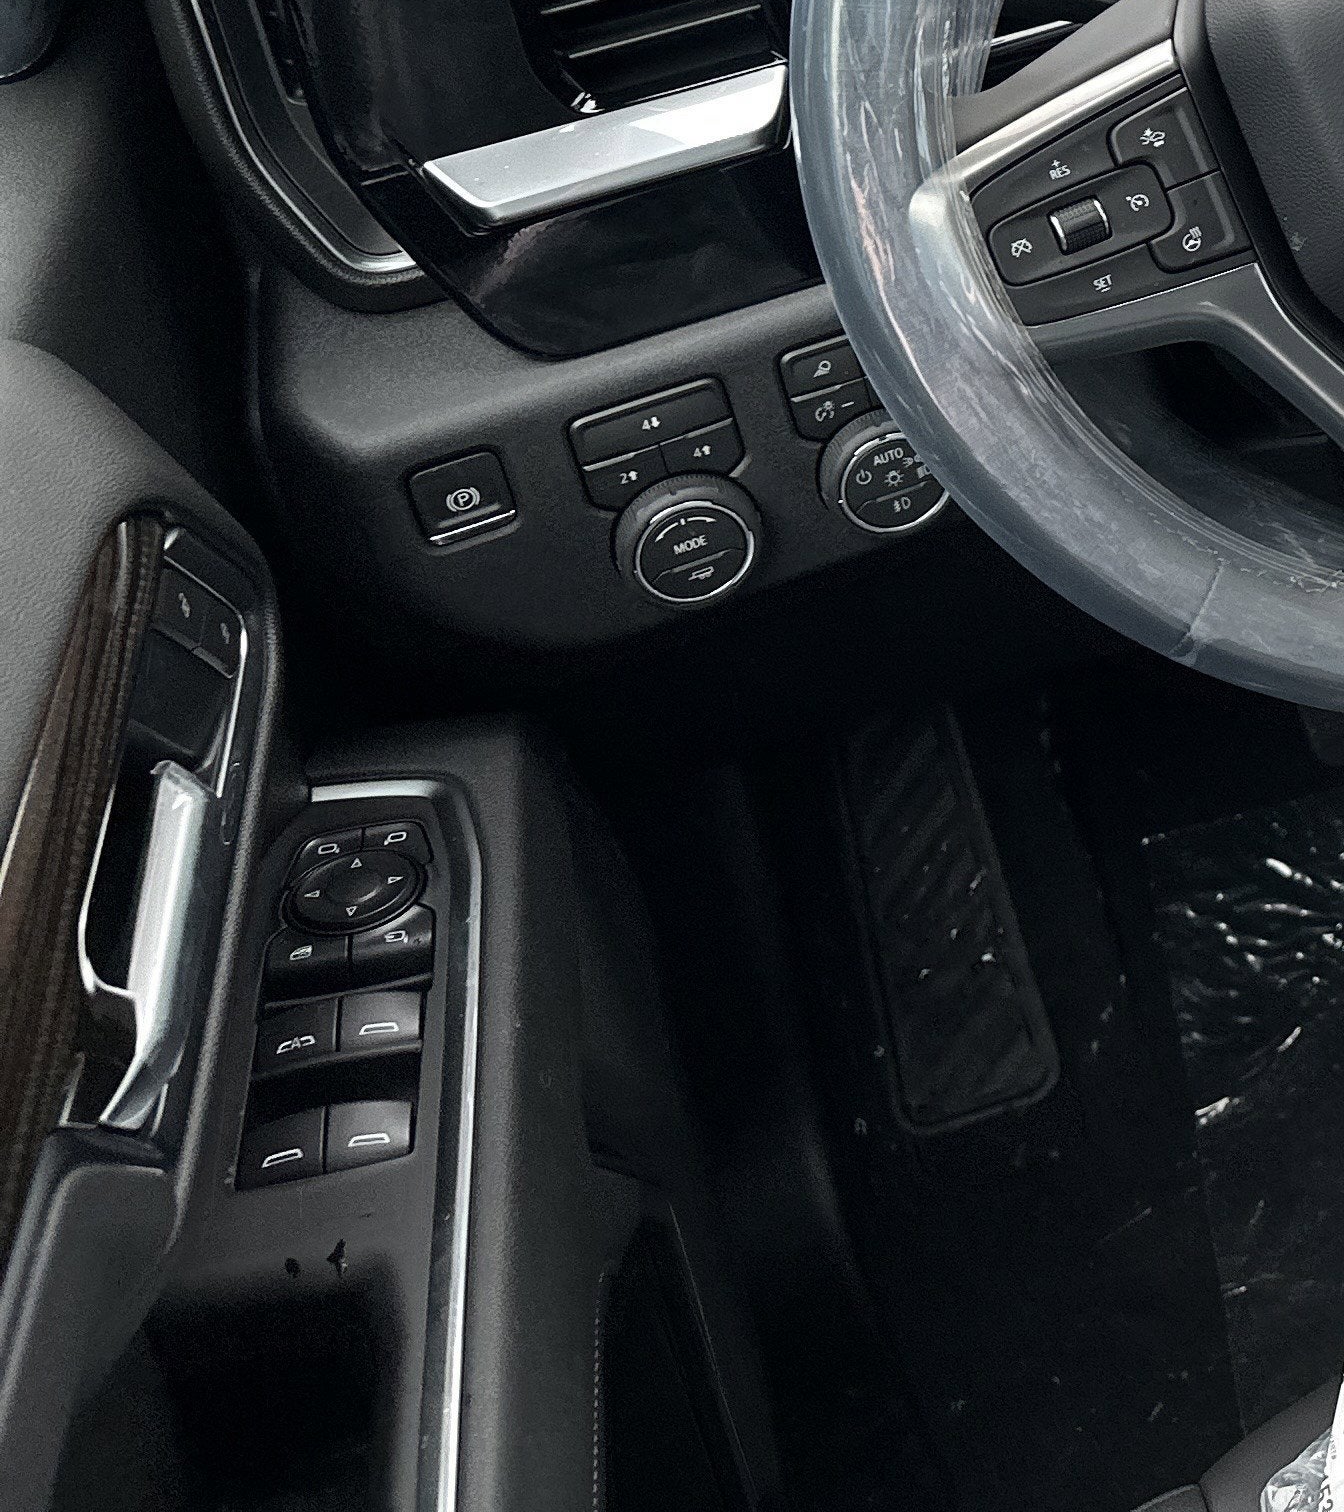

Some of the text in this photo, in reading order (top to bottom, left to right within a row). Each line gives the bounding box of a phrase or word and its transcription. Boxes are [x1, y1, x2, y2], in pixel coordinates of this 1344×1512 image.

[1049, 164, 1071, 180] RES
[1093, 274, 1113, 291] SET
[873, 447, 904, 466] AUTO
[673, 534, 708, 555] MODE
